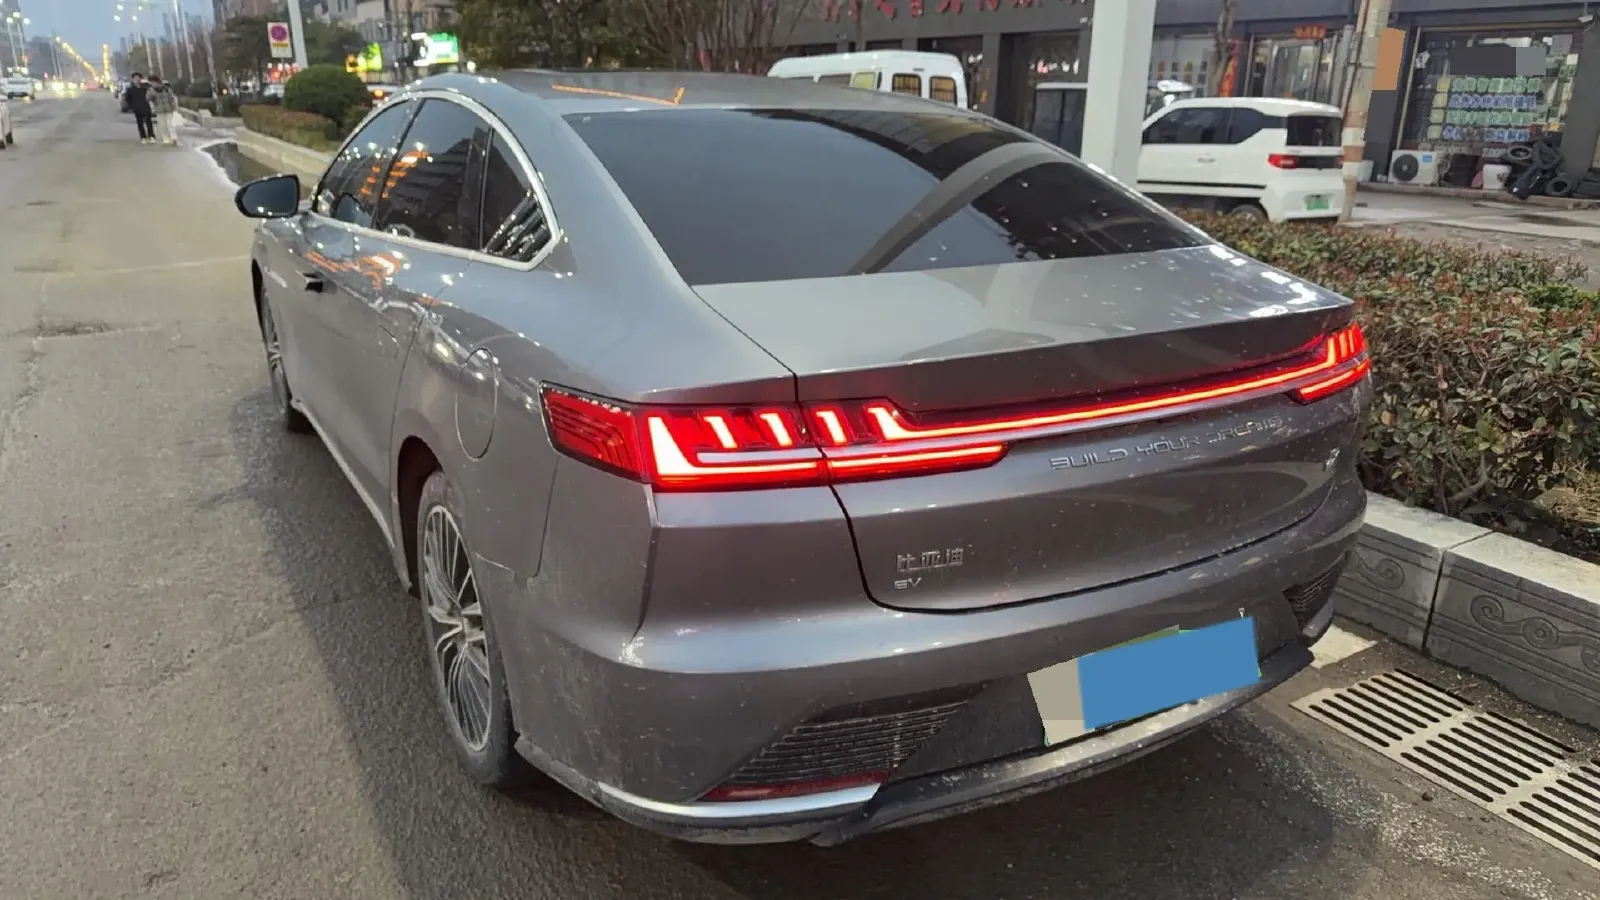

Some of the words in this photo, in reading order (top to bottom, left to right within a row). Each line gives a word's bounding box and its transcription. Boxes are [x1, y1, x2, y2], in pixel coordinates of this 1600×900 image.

[1050, 448, 1129, 470] BUILD
[1134, 436, 1201, 456] YOUR
[1206, 415, 1283, 443] DREAMS
[896, 548, 964, 572] 比亚迪
[893, 577, 922, 590] EV
